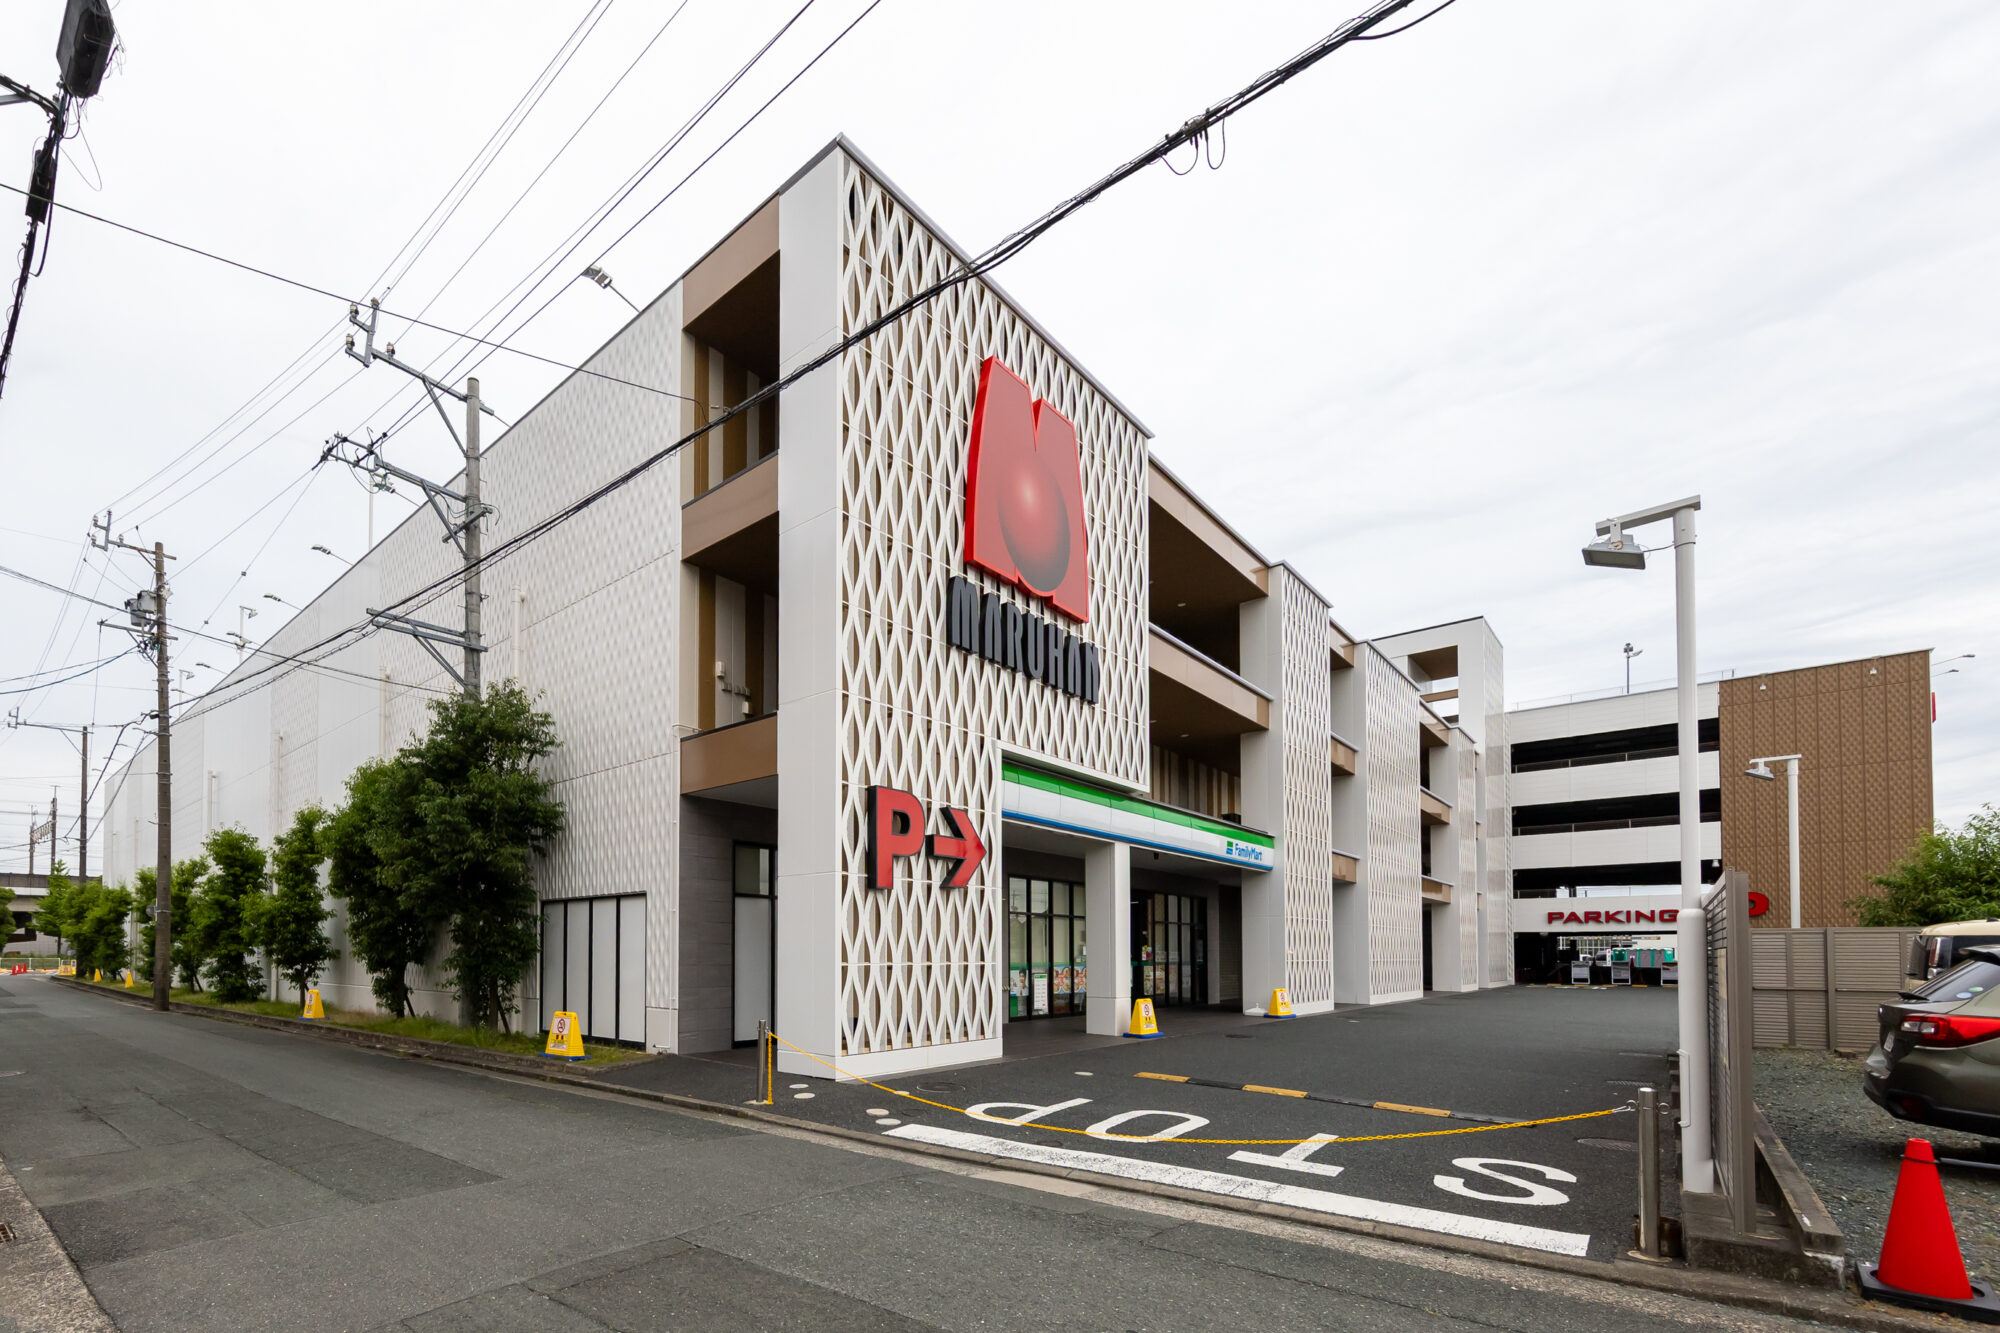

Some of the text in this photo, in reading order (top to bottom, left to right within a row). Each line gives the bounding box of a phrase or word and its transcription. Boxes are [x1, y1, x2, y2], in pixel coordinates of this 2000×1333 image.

[947, 576, 1099, 704] MARUHAN
[868, 786, 926, 890] P
[1235, 843, 1262, 861] FamilyMart
[1547, 908, 1679, 925] PARKING
